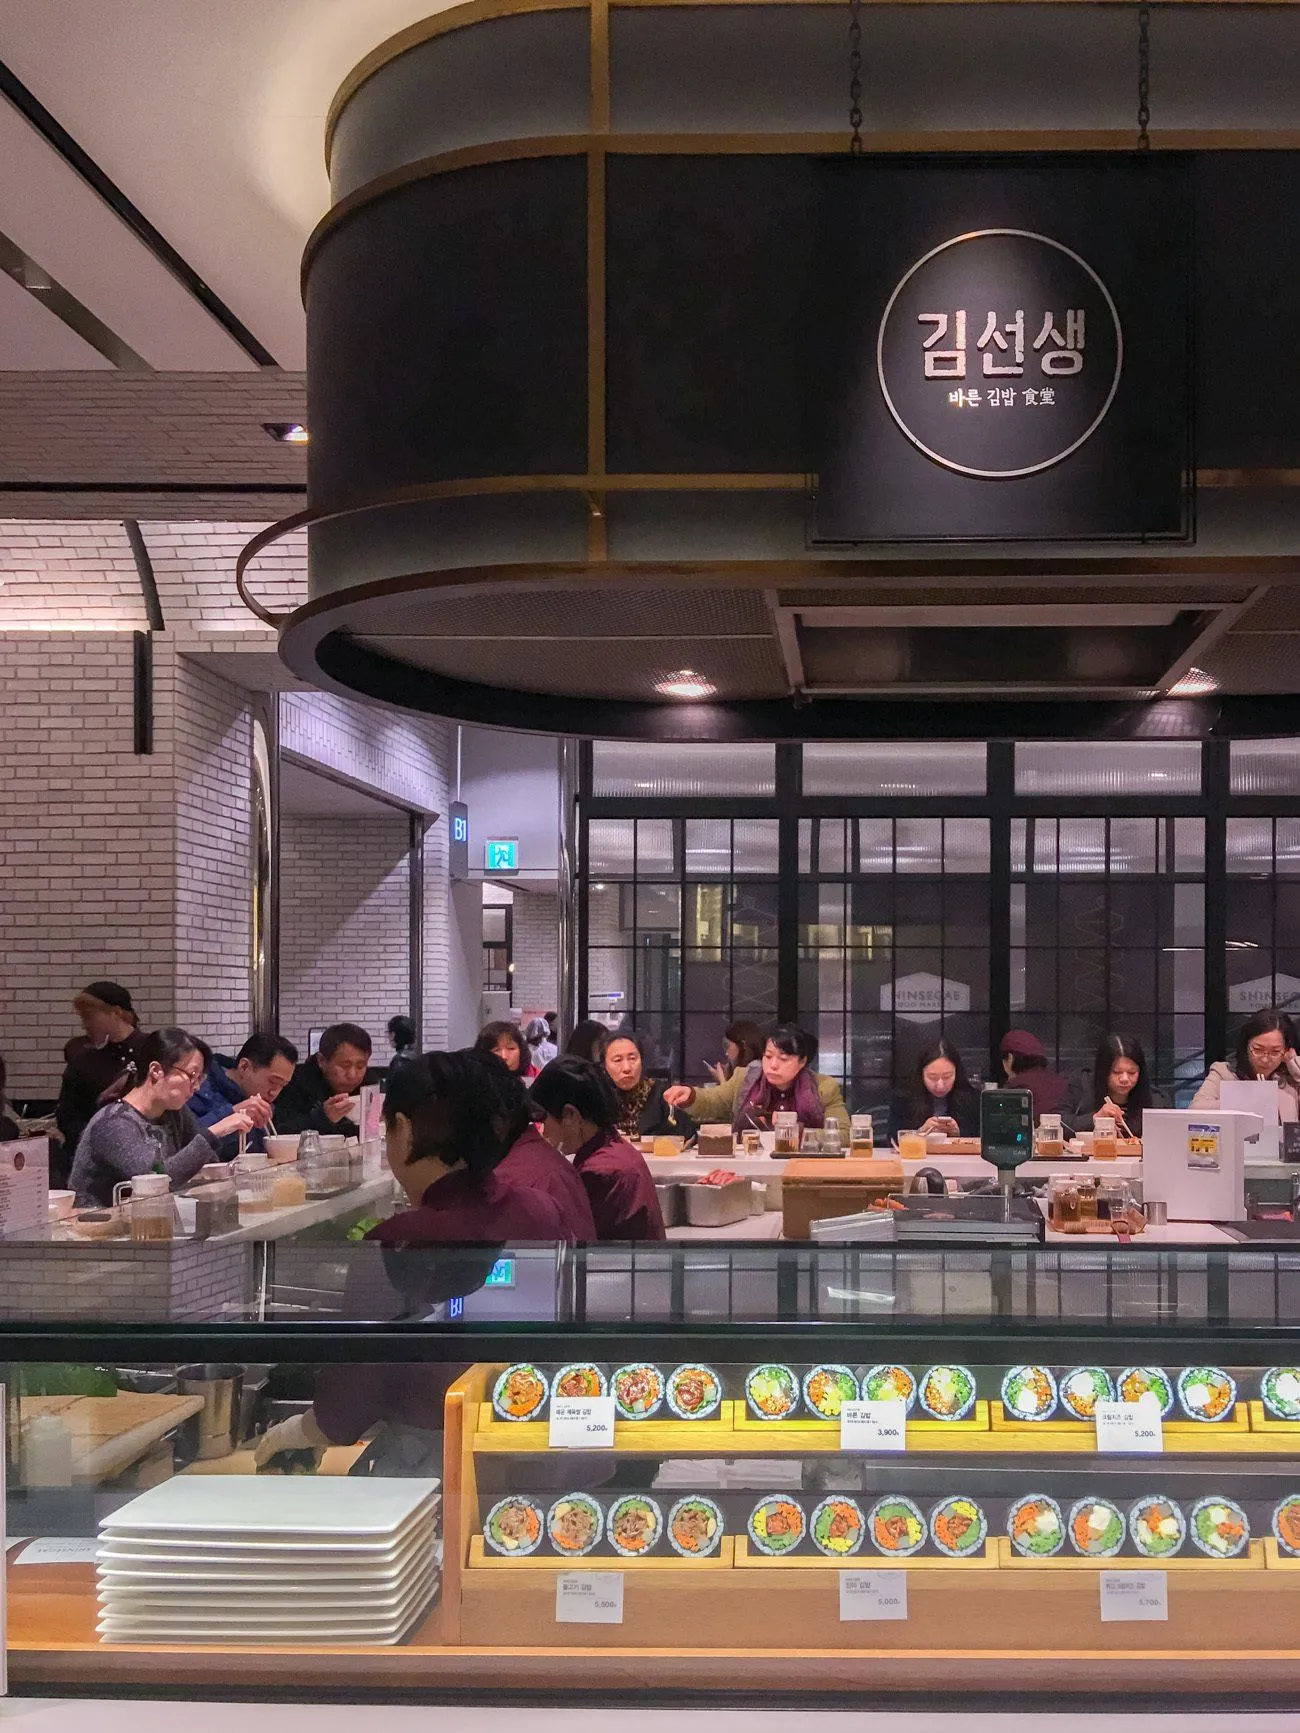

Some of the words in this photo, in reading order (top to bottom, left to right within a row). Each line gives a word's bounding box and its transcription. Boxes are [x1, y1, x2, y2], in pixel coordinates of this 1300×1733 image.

[918, 309, 1085, 379] 김선생
[949, 387, 982, 407] 바른
[987, 387, 1017, 407] 김밥
[1021, 386, 1056, 406] 食堂
[455, 817, 467, 841] B1
